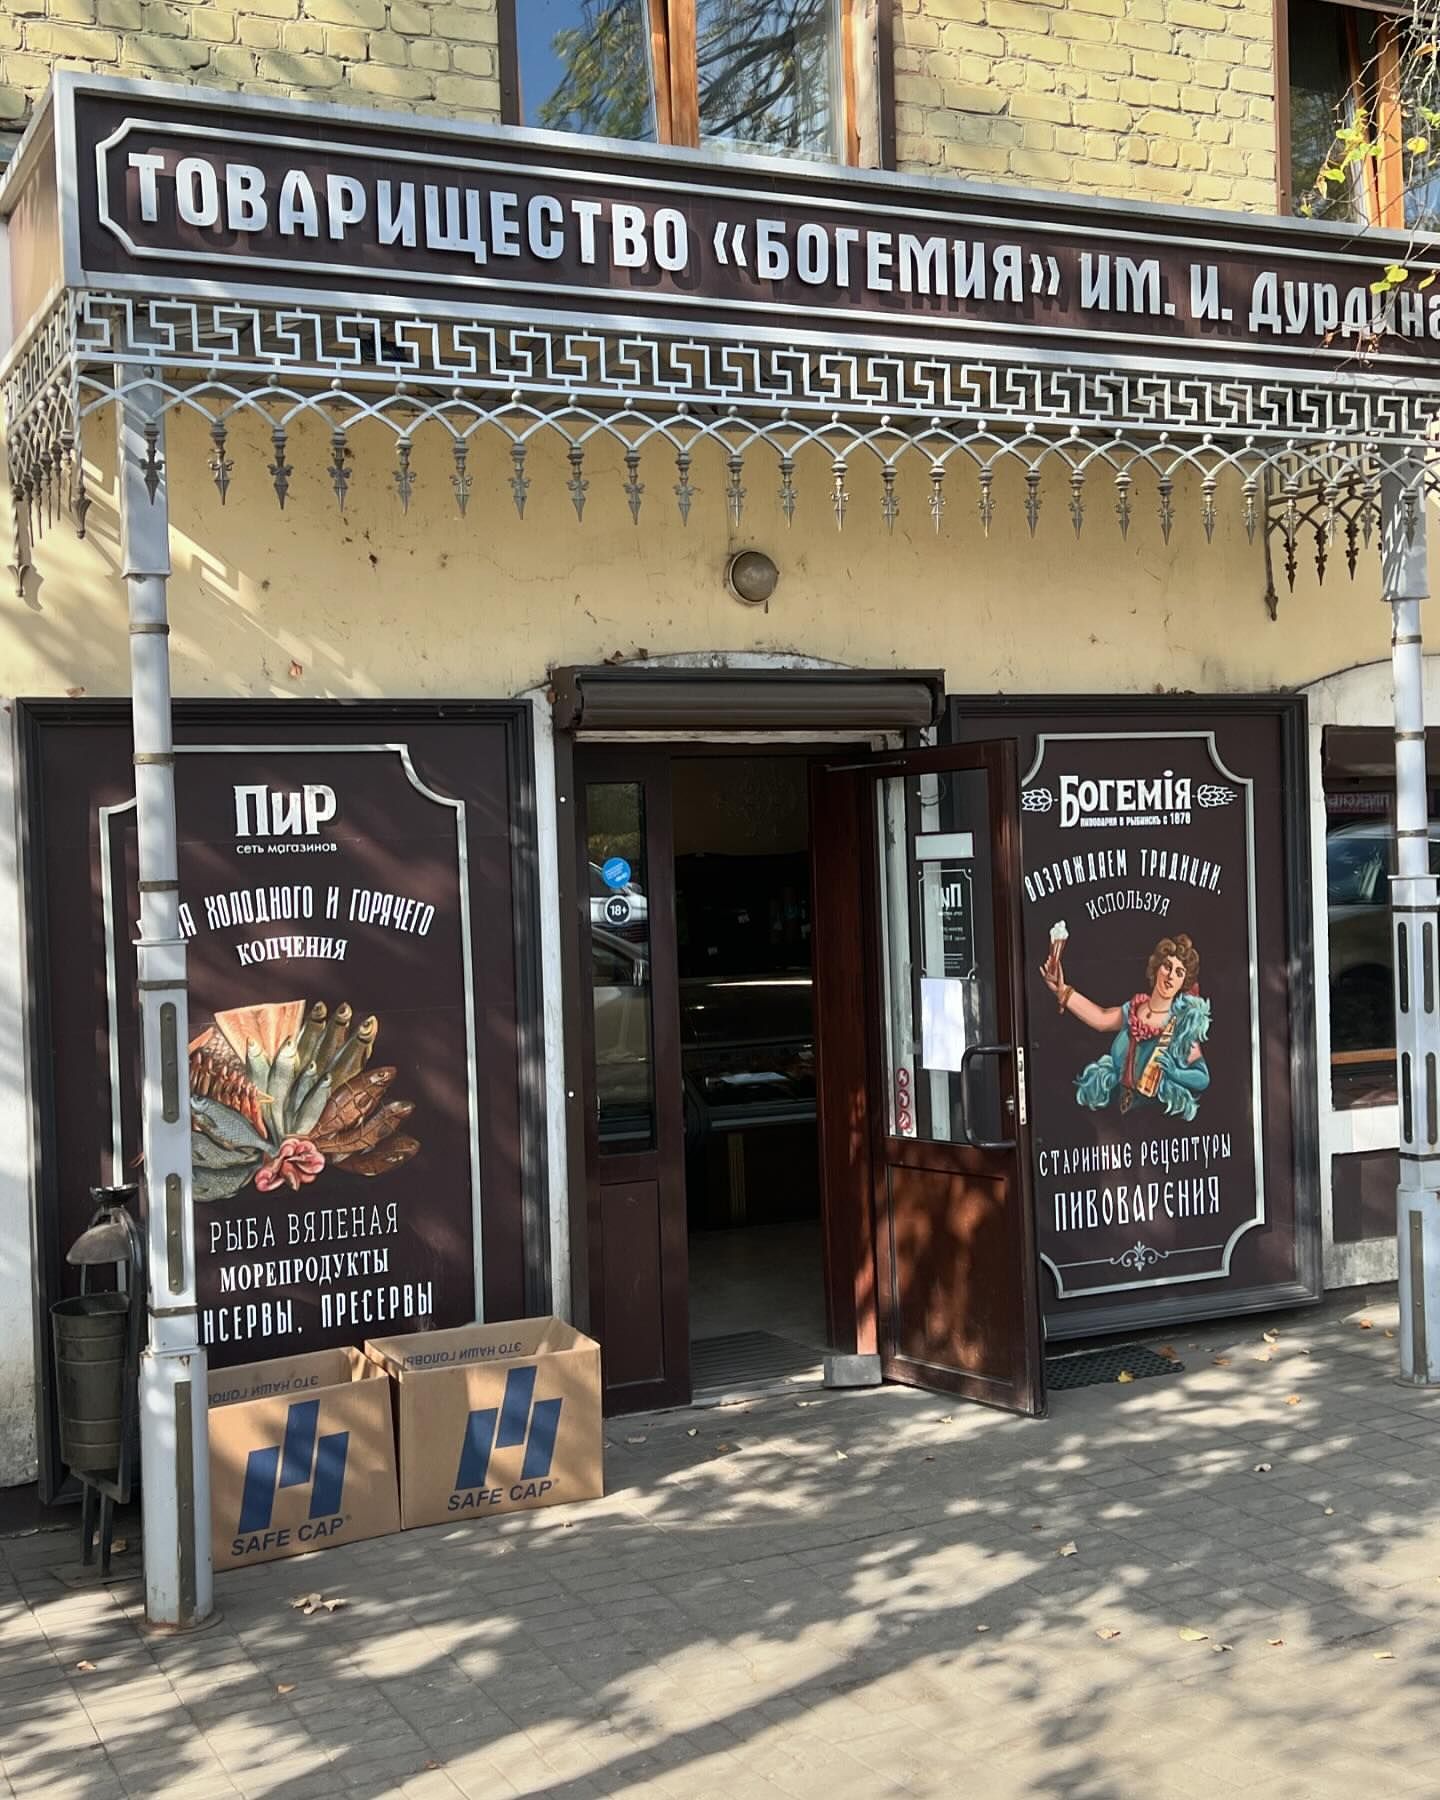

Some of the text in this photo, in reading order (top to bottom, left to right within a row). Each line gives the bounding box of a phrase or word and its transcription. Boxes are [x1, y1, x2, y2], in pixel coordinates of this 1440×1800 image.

[128, 152, 689, 272] ТОВАРИЩЕСТВО
[713, 218, 1060, 303] «БОГЕМИЯ»
[1080, 252, 1176, 316] ИМ.
[1190, 264, 1232, 321] И.
[236, 842, 338, 856] сеть магазинов
[1024, 848, 1128, 903] ВОЗРОЖДАЕМ
[204, 885, 313, 931] ХОЛОДНОГО
[325, 885, 340, 920] И
[349, 887, 436, 936] ГОРЯЧЕГО
[609, 904, 628, 917] 18+
[1085, 889, 1171, 920] ИСПОЛЬЗУЯ
[235, 935, 348, 967] КОПЧЕНИЯ
[1039, 1132, 1231, 1177] СТАРИННЫЕ РЕЦЕПТУРЫ
[1054, 1175, 1220, 1232] ПИВОВАРЕНИЯ
[209, 1202, 399, 1254] РЫБА ВЯЛЕНАЯ
[219, 1247, 390, 1293] МОРЕПРОДУКТЫ
[203, 1281, 433, 1345] НСЕРВЫ, ПРЕСЕРВЫ
[459, 1345, 496, 1361] НАШИ
[498, 1342, 523, 1355] ЭТО
[251, 1380, 290, 1397] НАШИ
[294, 1376, 319, 1389] ЭТО
[447, 1487, 504, 1511] SAFE
[231, 1531, 291, 1556] SAFE
